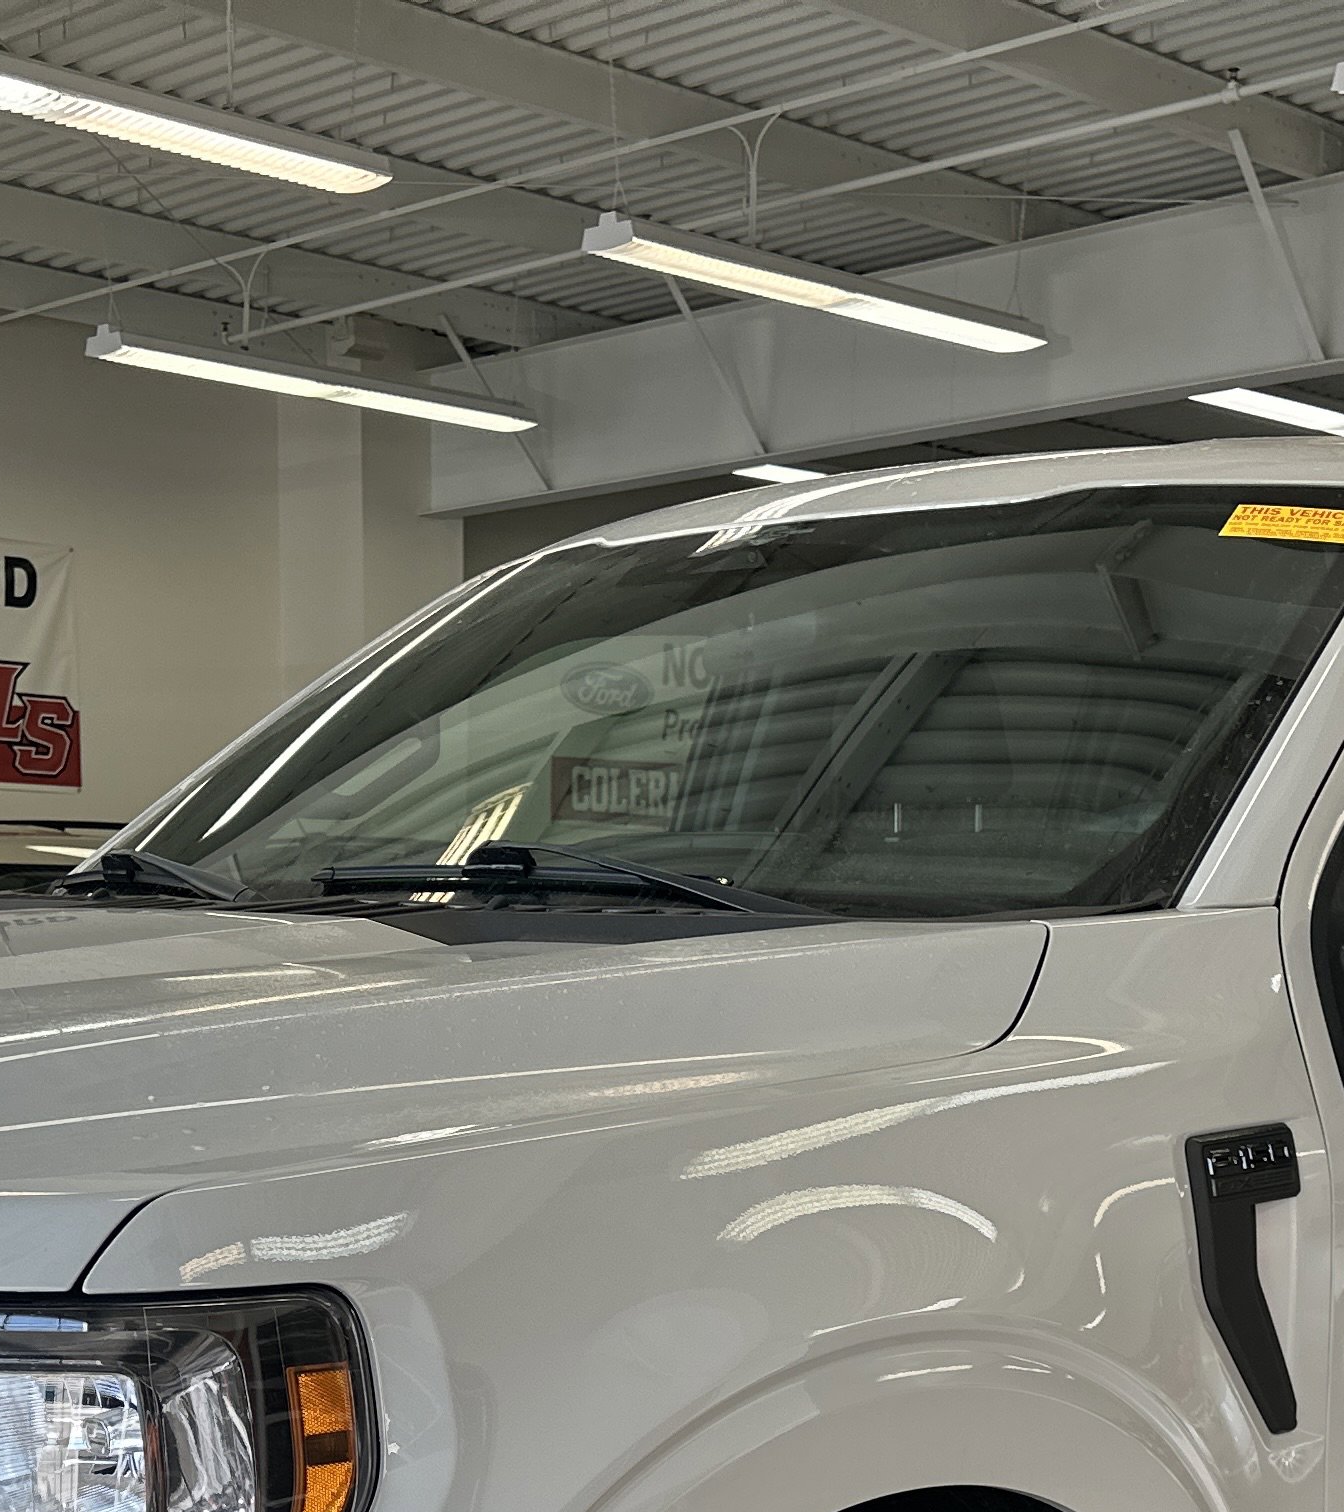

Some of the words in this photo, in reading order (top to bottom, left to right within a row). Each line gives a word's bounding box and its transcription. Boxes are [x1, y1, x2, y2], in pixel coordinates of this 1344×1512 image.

[1240, 506, 1282, 516] THIS
[1260, 516, 1301, 524] READY
[1305, 518, 1331, 526] FOR
[576, 670, 640, 709] Ford
